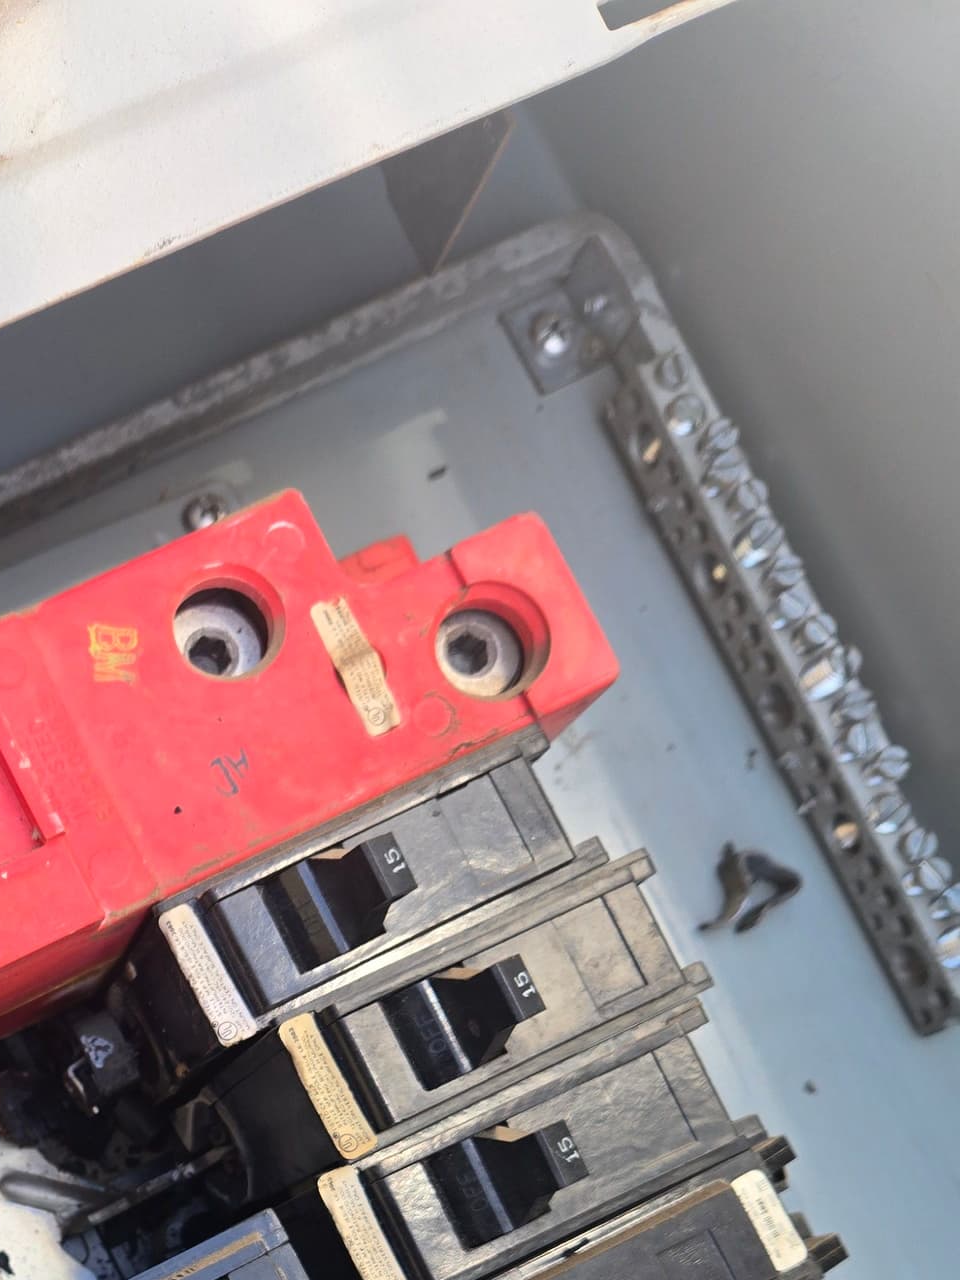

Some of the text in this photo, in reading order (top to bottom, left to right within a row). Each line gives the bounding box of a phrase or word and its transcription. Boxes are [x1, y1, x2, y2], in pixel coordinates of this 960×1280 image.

[384, 847, 409, 875] 15
[513, 970, 536, 998] 15
[556, 1134, 580, 1163] 15
